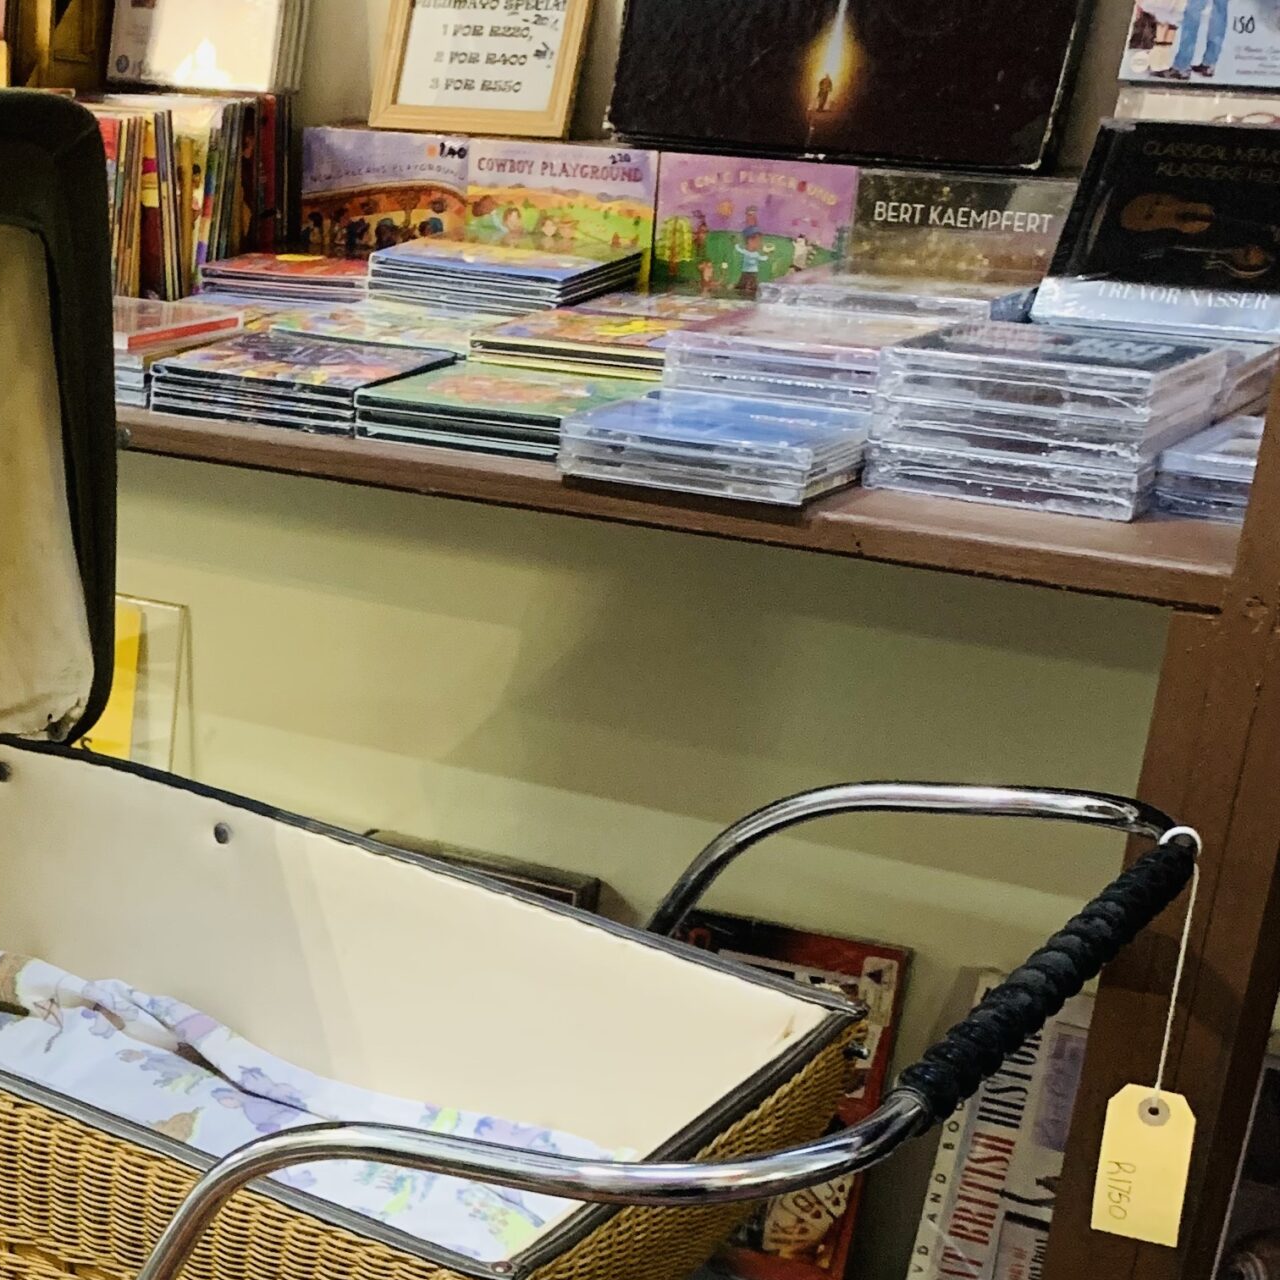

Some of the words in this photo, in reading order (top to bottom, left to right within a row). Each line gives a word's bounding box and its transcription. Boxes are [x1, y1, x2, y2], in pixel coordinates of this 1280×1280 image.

[452, 25, 483, 37] FOR
[448, 52, 480, 64] FOR
[485, 52, 528, 66] R400
[444, 79, 475, 91] FOR
[478, 157, 534, 175] COWBOY
[540, 161, 644, 183] PLAYGROUND
[874, 200, 925, 224] BERT
[928, 205, 1053, 234] KAEMPFERT
[1098, 280, 1178, 304] TREVOR
[1189, 289, 1269, 310] NASSER
[977, 1033, 1042, 1129] HISTO
[928, 1173, 947, 1223] AND
[943, 1100, 965, 1150] BOO
[948, 1131, 1016, 1245] BRITISH
[1106, 1160, 1136, 1220] R1750
